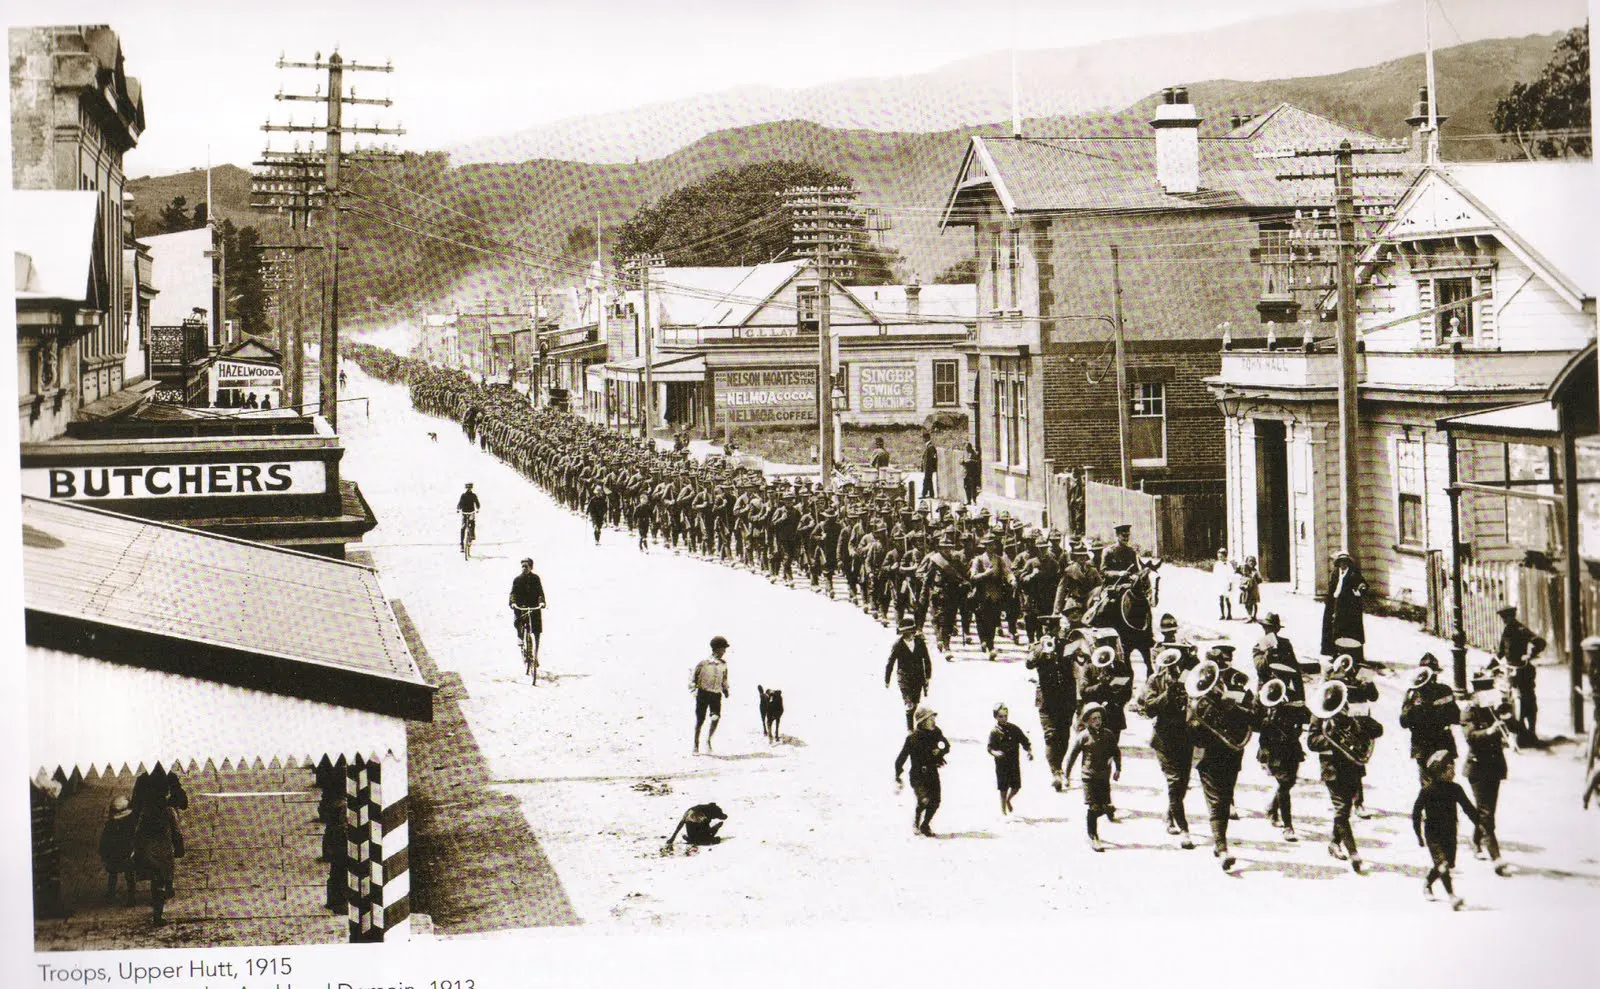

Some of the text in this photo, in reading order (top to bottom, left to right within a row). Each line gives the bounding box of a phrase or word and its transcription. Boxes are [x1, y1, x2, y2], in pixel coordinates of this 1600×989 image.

[218, 364, 275, 377] HAZELWOOD
[861, 368, 915, 383] SINGER
[726, 370, 800, 387] NELSON MOATES
[862, 384, 901, 396] SEWING
[726, 391, 777, 406] NELMOA
[776, 391, 815, 401] COCOA
[727, 408, 776, 422] NELMOA
[49, 463, 293, 498] BUTCHERS
